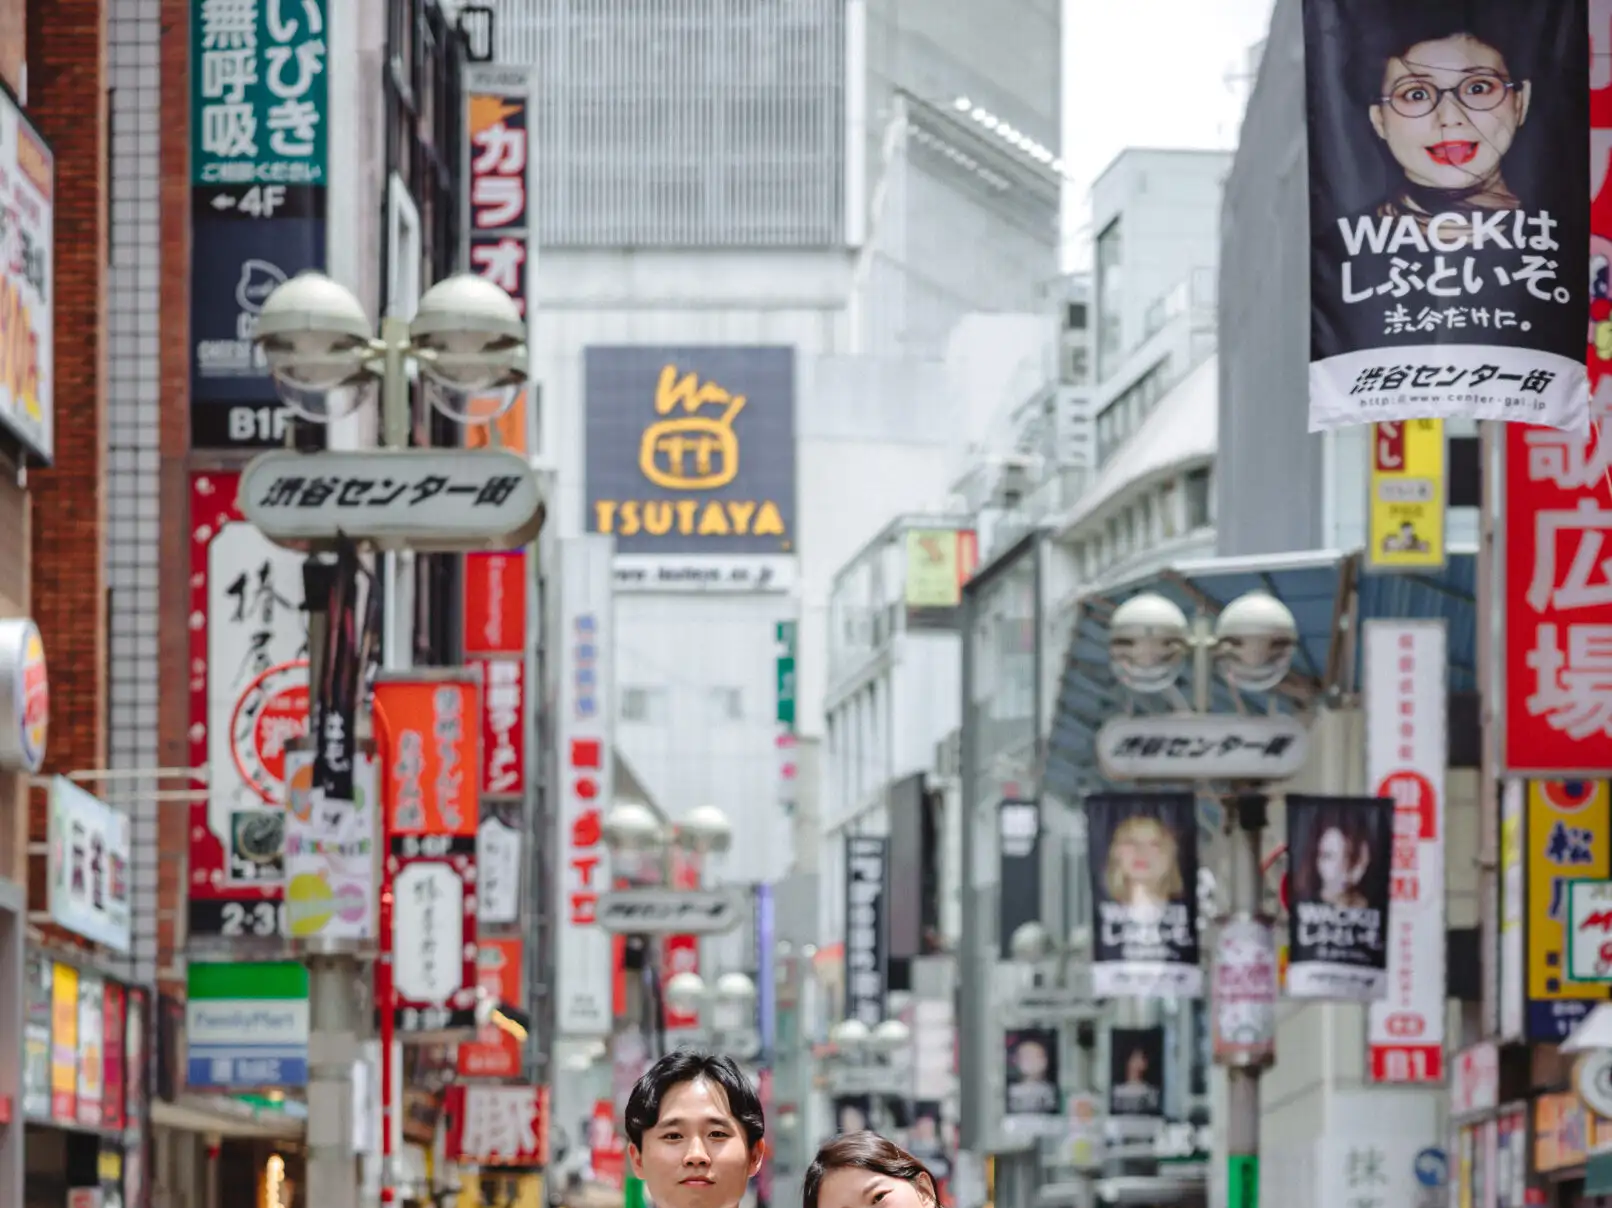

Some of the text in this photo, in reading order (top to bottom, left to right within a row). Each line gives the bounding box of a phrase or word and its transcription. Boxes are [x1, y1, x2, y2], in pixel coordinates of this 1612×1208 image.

[265, 0, 325, 157] いびき
[1337, 209, 1560, 256] WACKは
[1341, 254, 1570, 304] しぶといぞ。
[1383, 303, 1532, 335] 渋谷だけに。
[1350, 364, 1556, 395] 渋谷センター街
[259, 475, 522, 507] 渋谷センター街
[595, 500, 785, 536] TSUTAYA
